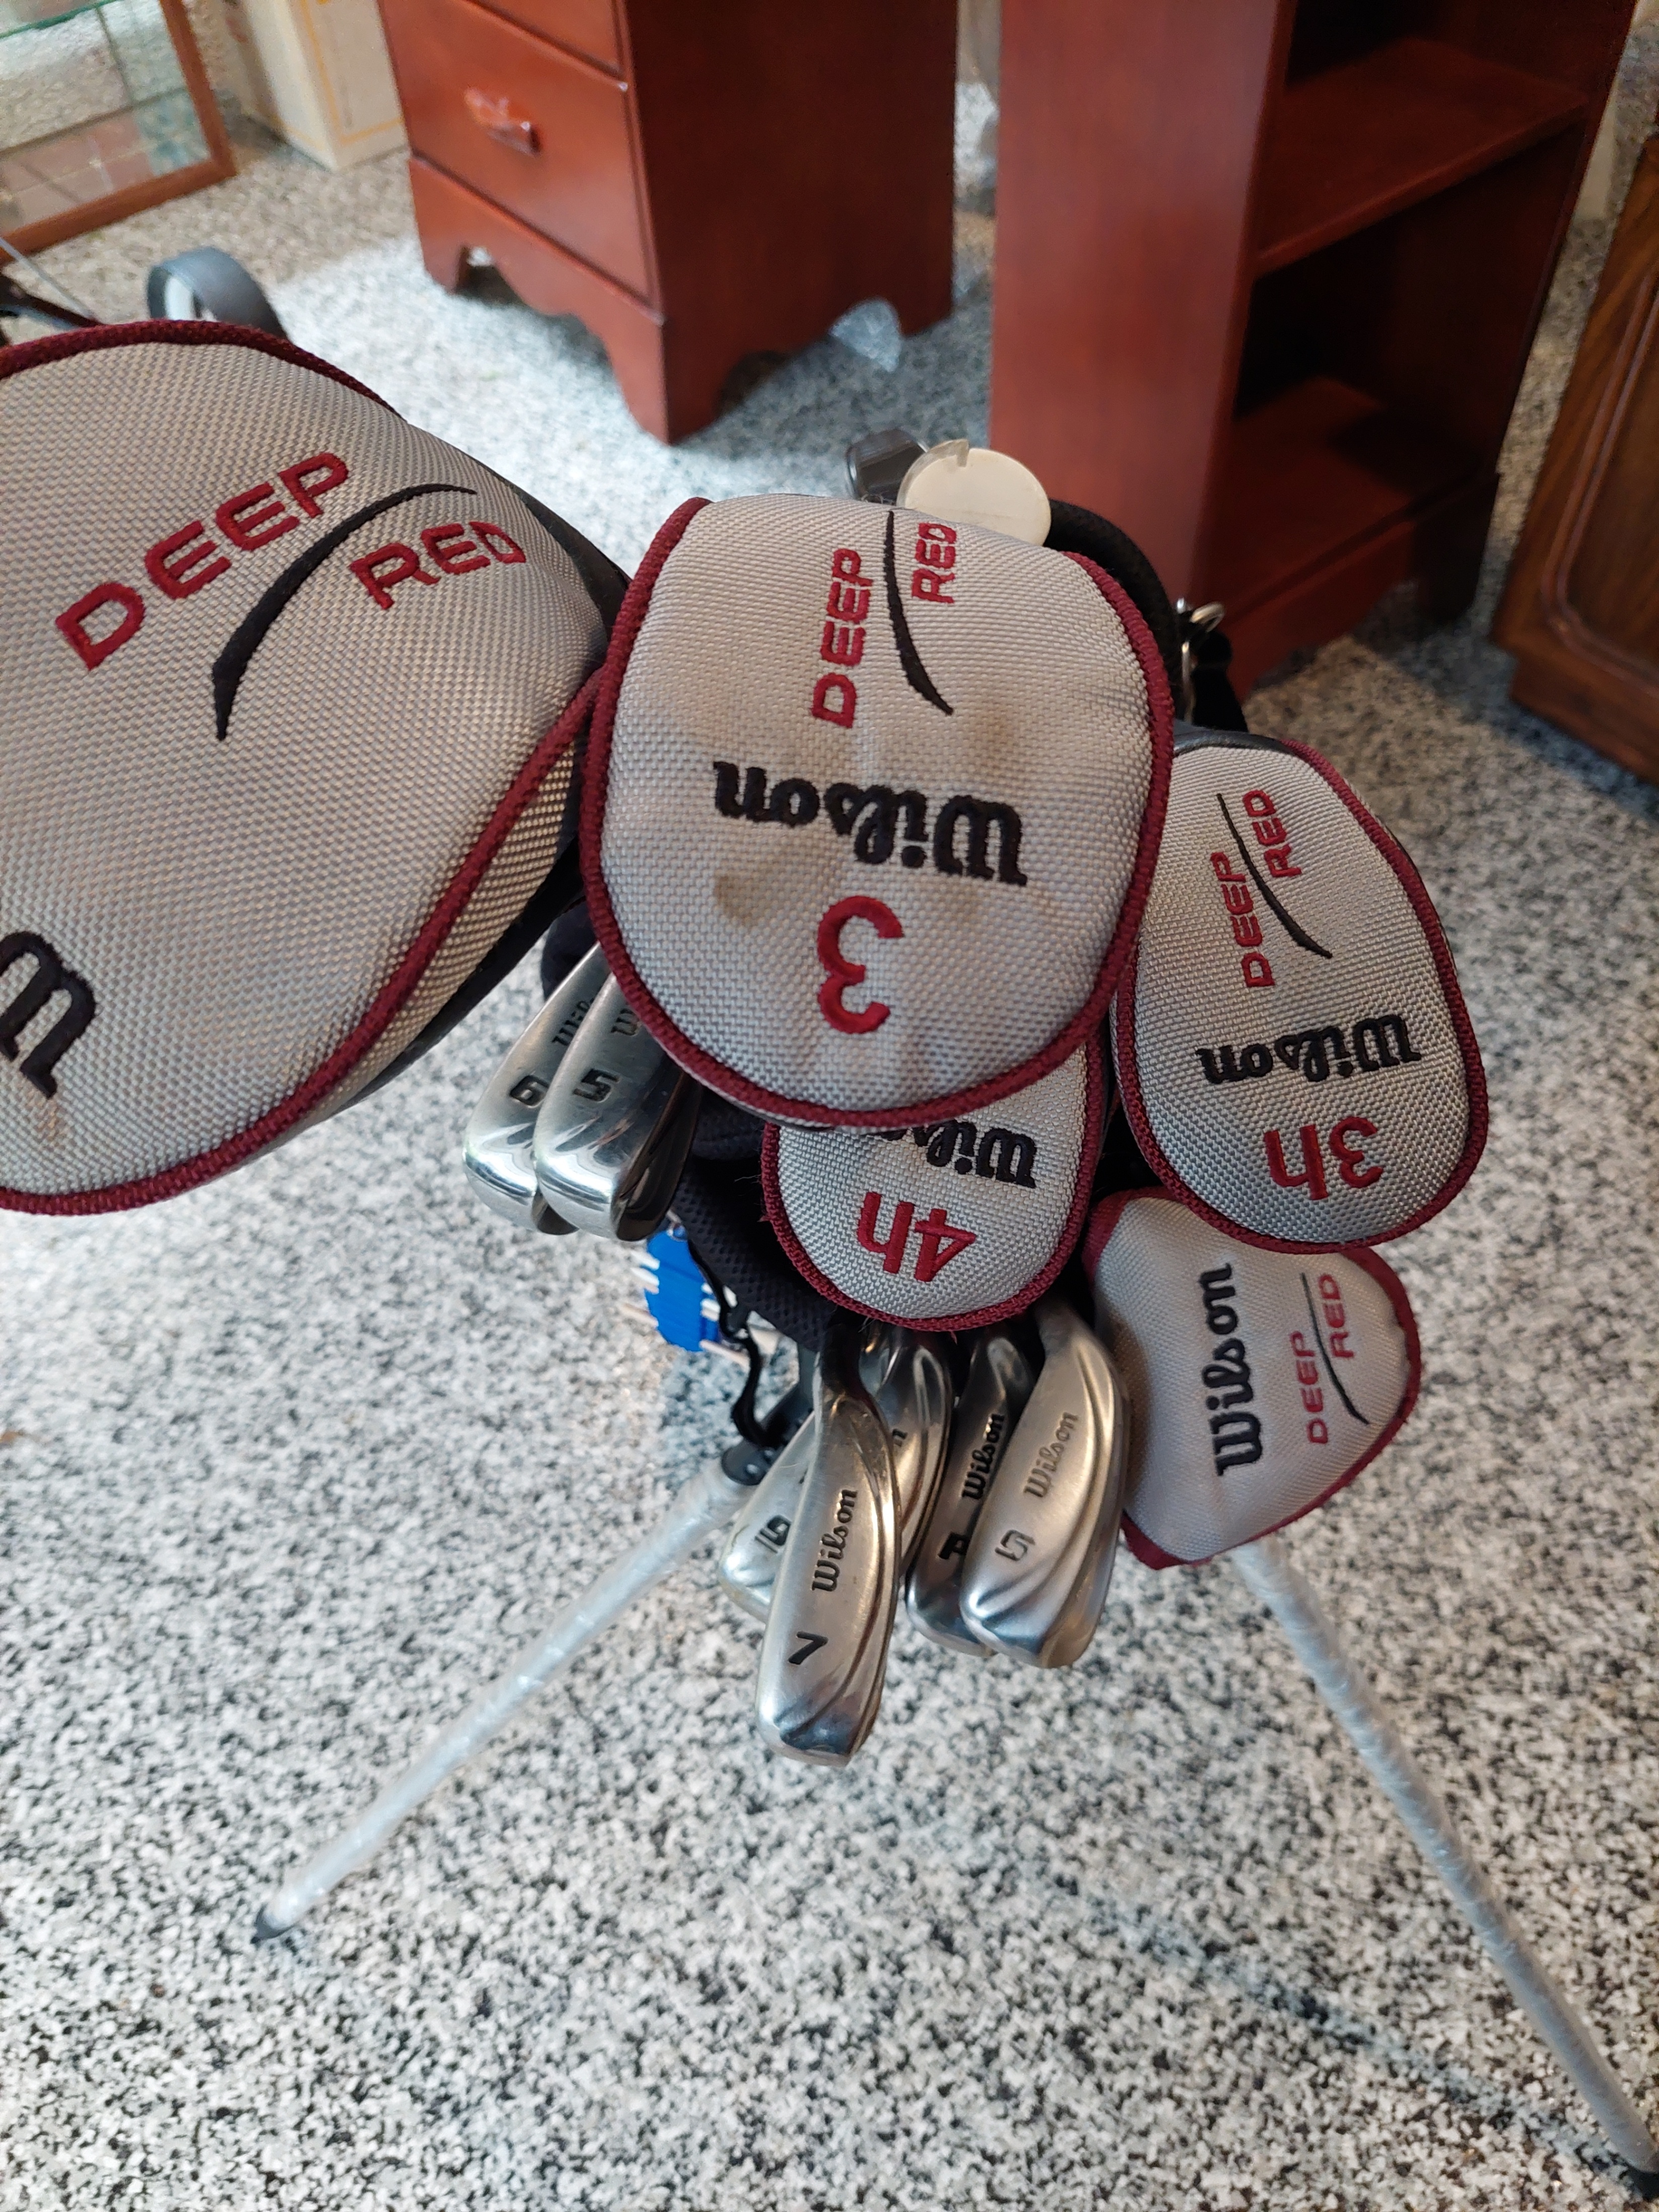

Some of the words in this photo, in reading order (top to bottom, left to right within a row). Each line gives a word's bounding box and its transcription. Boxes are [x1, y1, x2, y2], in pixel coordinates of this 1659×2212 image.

[55, 452, 350, 670] DEEP
[350, 521, 526, 611] RED
[910, 522, 958, 604] RED
[810, 547, 874, 729] DEEP
[712, 761, 1028, 887] Wilson
[1242, 789, 1302, 878] RED
[1210, 851, 1276, 988] DEEP
[817, 894, 905, 1035] 3
[509, 1075, 550, 1107] 6
[573, 1069, 620, 1102] 5
[1195, 1012, 1422, 1086] Wilson
[1263, 1115, 1383, 1200] 3h
[857, 1192, 977, 1282] 4h
[1318, 1274, 1354, 1359] RED
[1197, 1263, 1263, 1477] Wilson
[1290, 1331, 1329, 1444] DEEP
[961, 1413, 1005, 1500] Wilson
[1023, 1412, 1079, 1497] Wilson
[811, 1489, 858, 1592] Wilson
[788, 1631, 829, 1665] 7
